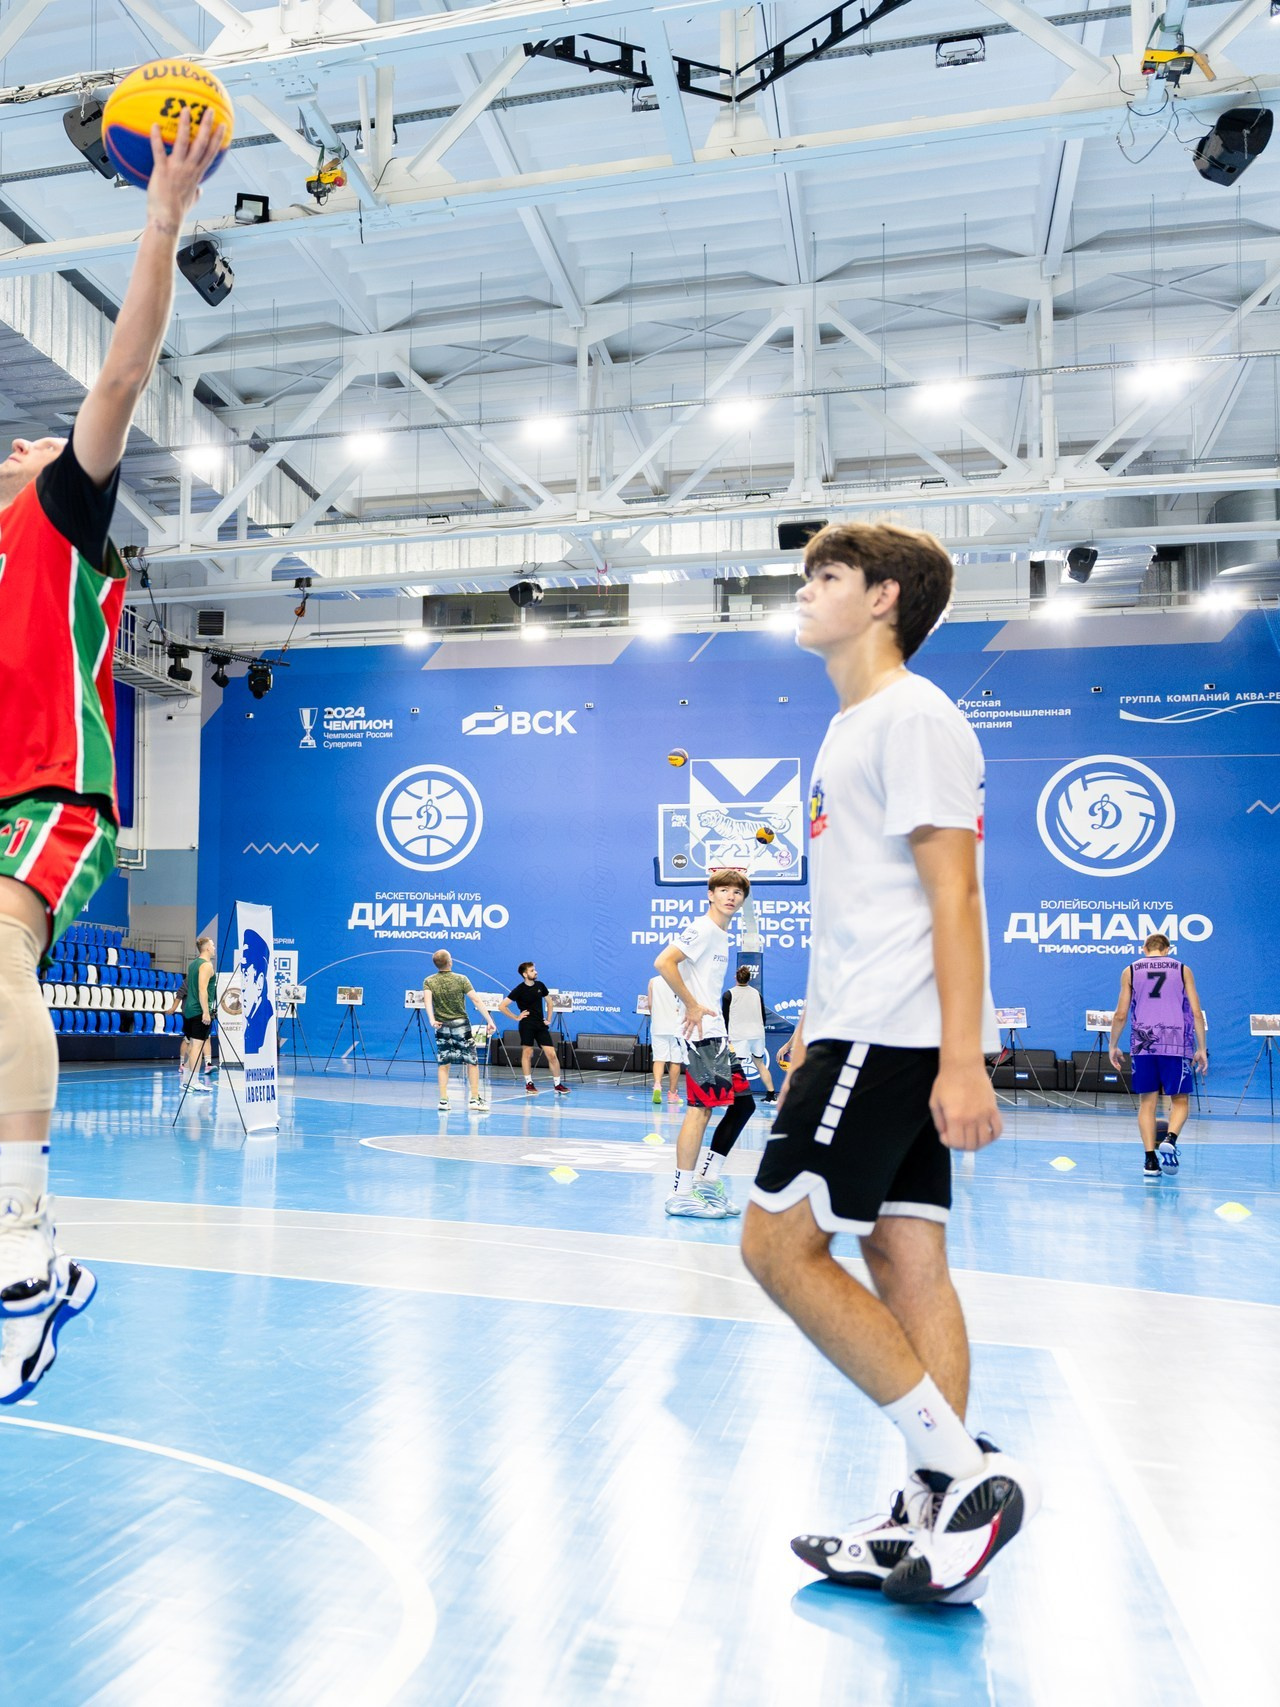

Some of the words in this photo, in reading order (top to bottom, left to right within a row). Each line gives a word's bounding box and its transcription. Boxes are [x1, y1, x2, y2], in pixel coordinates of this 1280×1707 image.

[143, 65, 222, 93] Wilson
[1120, 694, 1161, 704] ГРУППА
[1166, 691, 1230, 703] КОМПАНИЙ
[957, 699, 1001, 710] Русская
[323, 706, 366, 719] 2024
[323, 719, 393, 731] ЧЕМПИОН
[511, 710, 578, 737] ВСК
[323, 732, 365, 740] Чемпионат
[366, 731, 393, 739] России
[323, 740, 363, 750] Суперлига
[375, 891, 456, 901] БАСКЕТБОЛЬНЫЙ
[457, 892, 482, 901] КЛУБ
[651, 899, 694, 913] ПРИ
[1040, 898, 1140, 910] ВОЛЕЙБОЛЬНЫЙ
[1142, 901, 1174, 910] КЛУБ
[347, 902, 510, 930] ДИНАМО
[1003, 912, 1214, 944] ДИНАМО
[374, 929, 449, 940] ПРИМОРСКИЙ
[450, 930, 481, 941] КРАЙ
[1038, 943, 1135, 955] ПРИМОРСКИЙ
[1146, 971, 1167, 998] 7
[245, 1065, 275, 1081] ИРИНОВСКИЙ
[245, 1085, 276, 1103] АВСЕГДА
